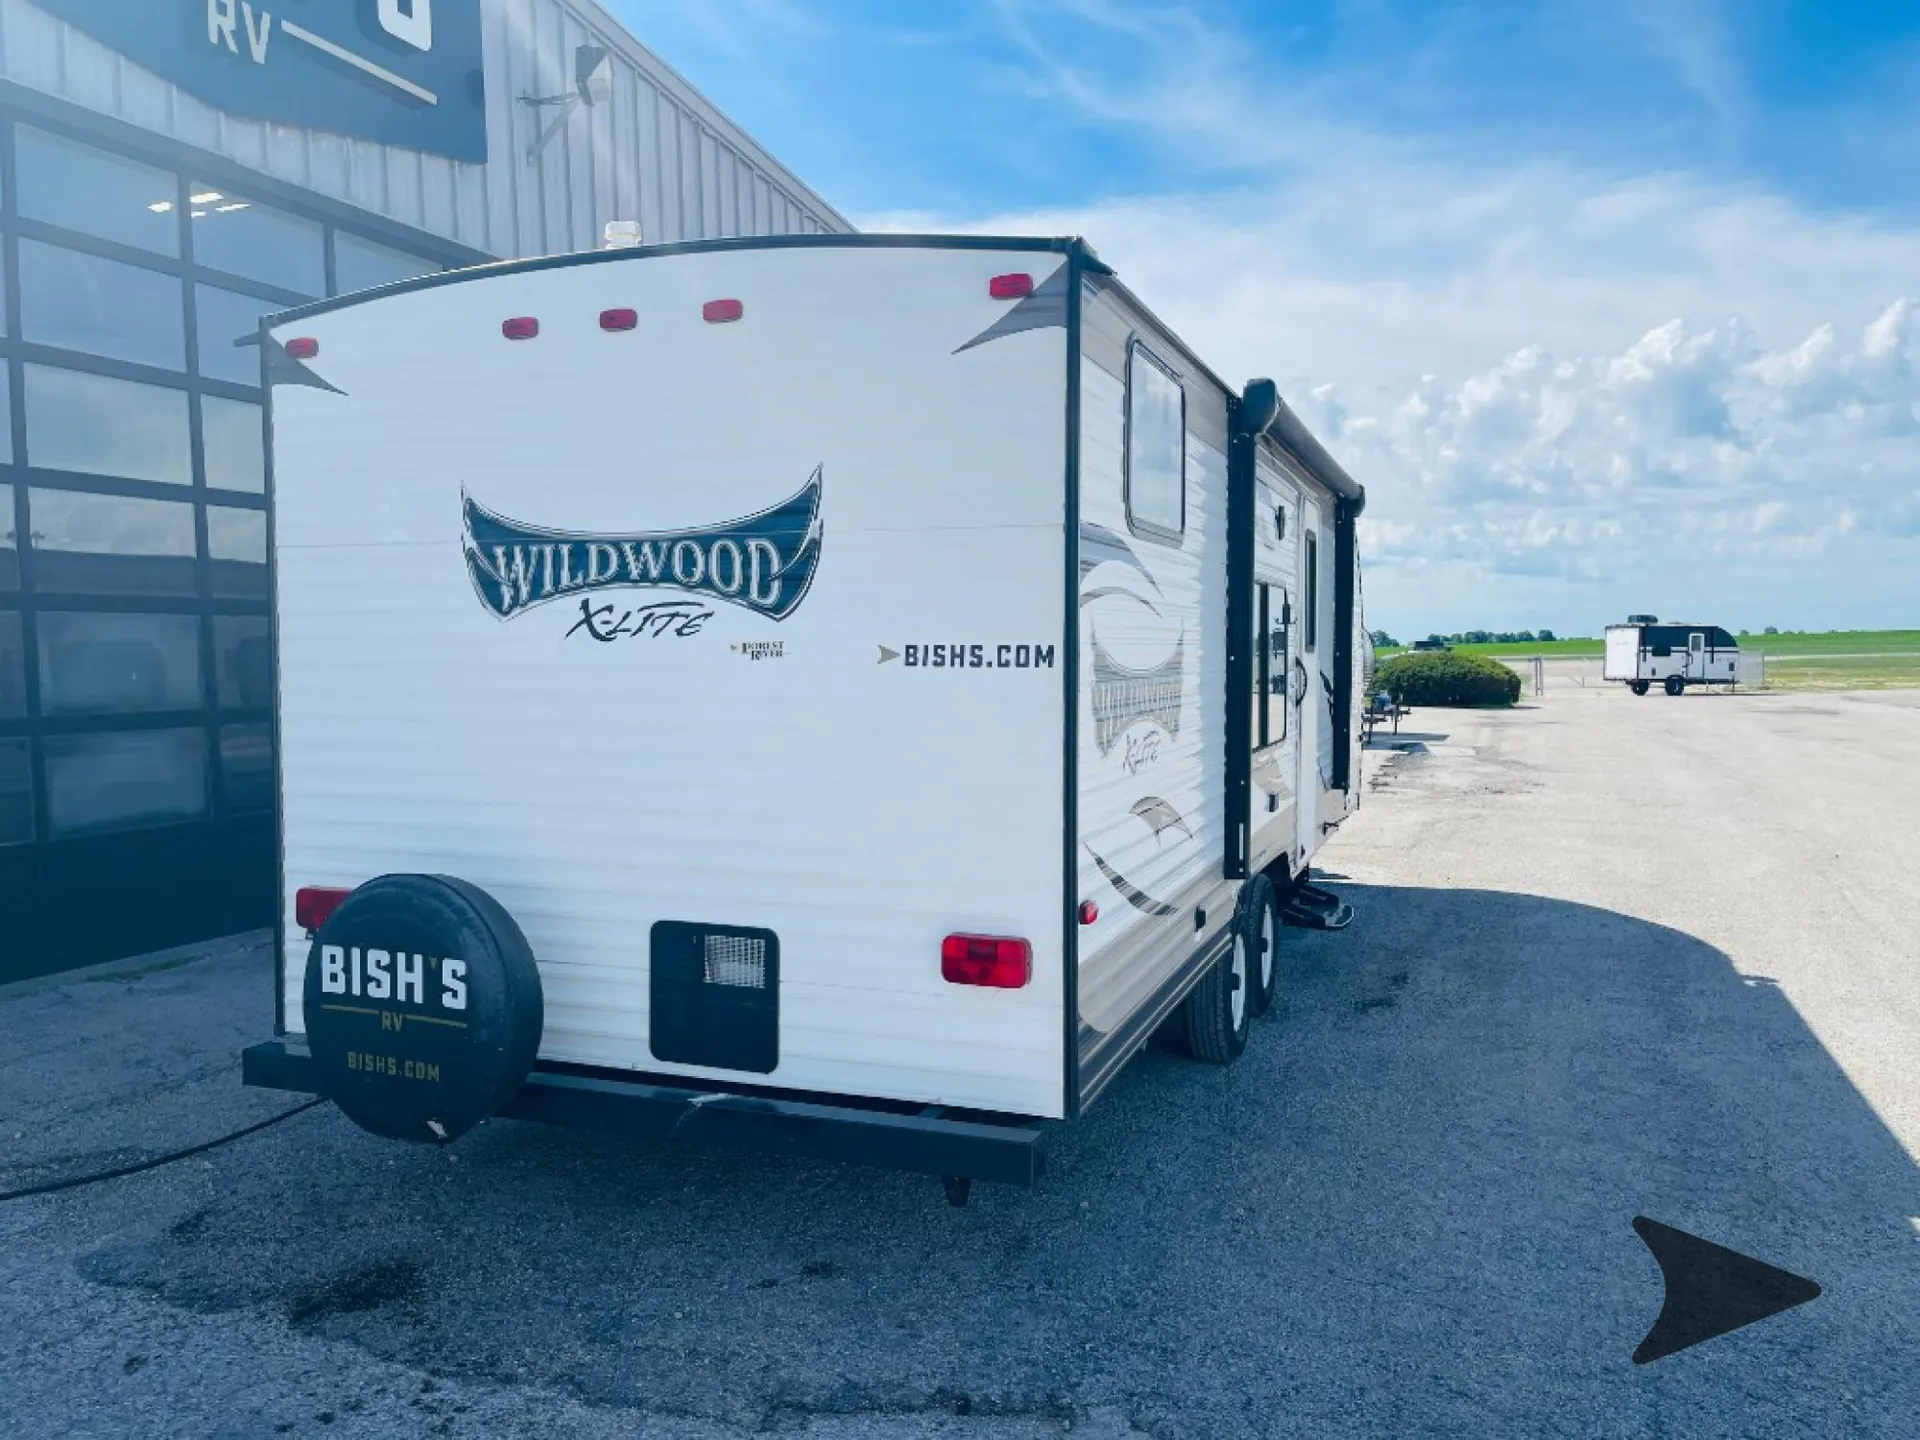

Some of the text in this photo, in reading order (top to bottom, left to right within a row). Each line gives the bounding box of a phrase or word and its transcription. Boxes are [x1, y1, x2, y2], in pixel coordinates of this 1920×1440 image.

[207, 0, 271, 64] RV
[493, 537, 783, 614] WILDWOOD
[564, 597, 714, 641] X-LITE
[904, 644, 1055, 668] BISHS.COM
[321, 944, 467, 1010] BISH'S
[381, 1011, 404, 1032] RV
[348, 1051, 441, 1082] BISHS.COM
